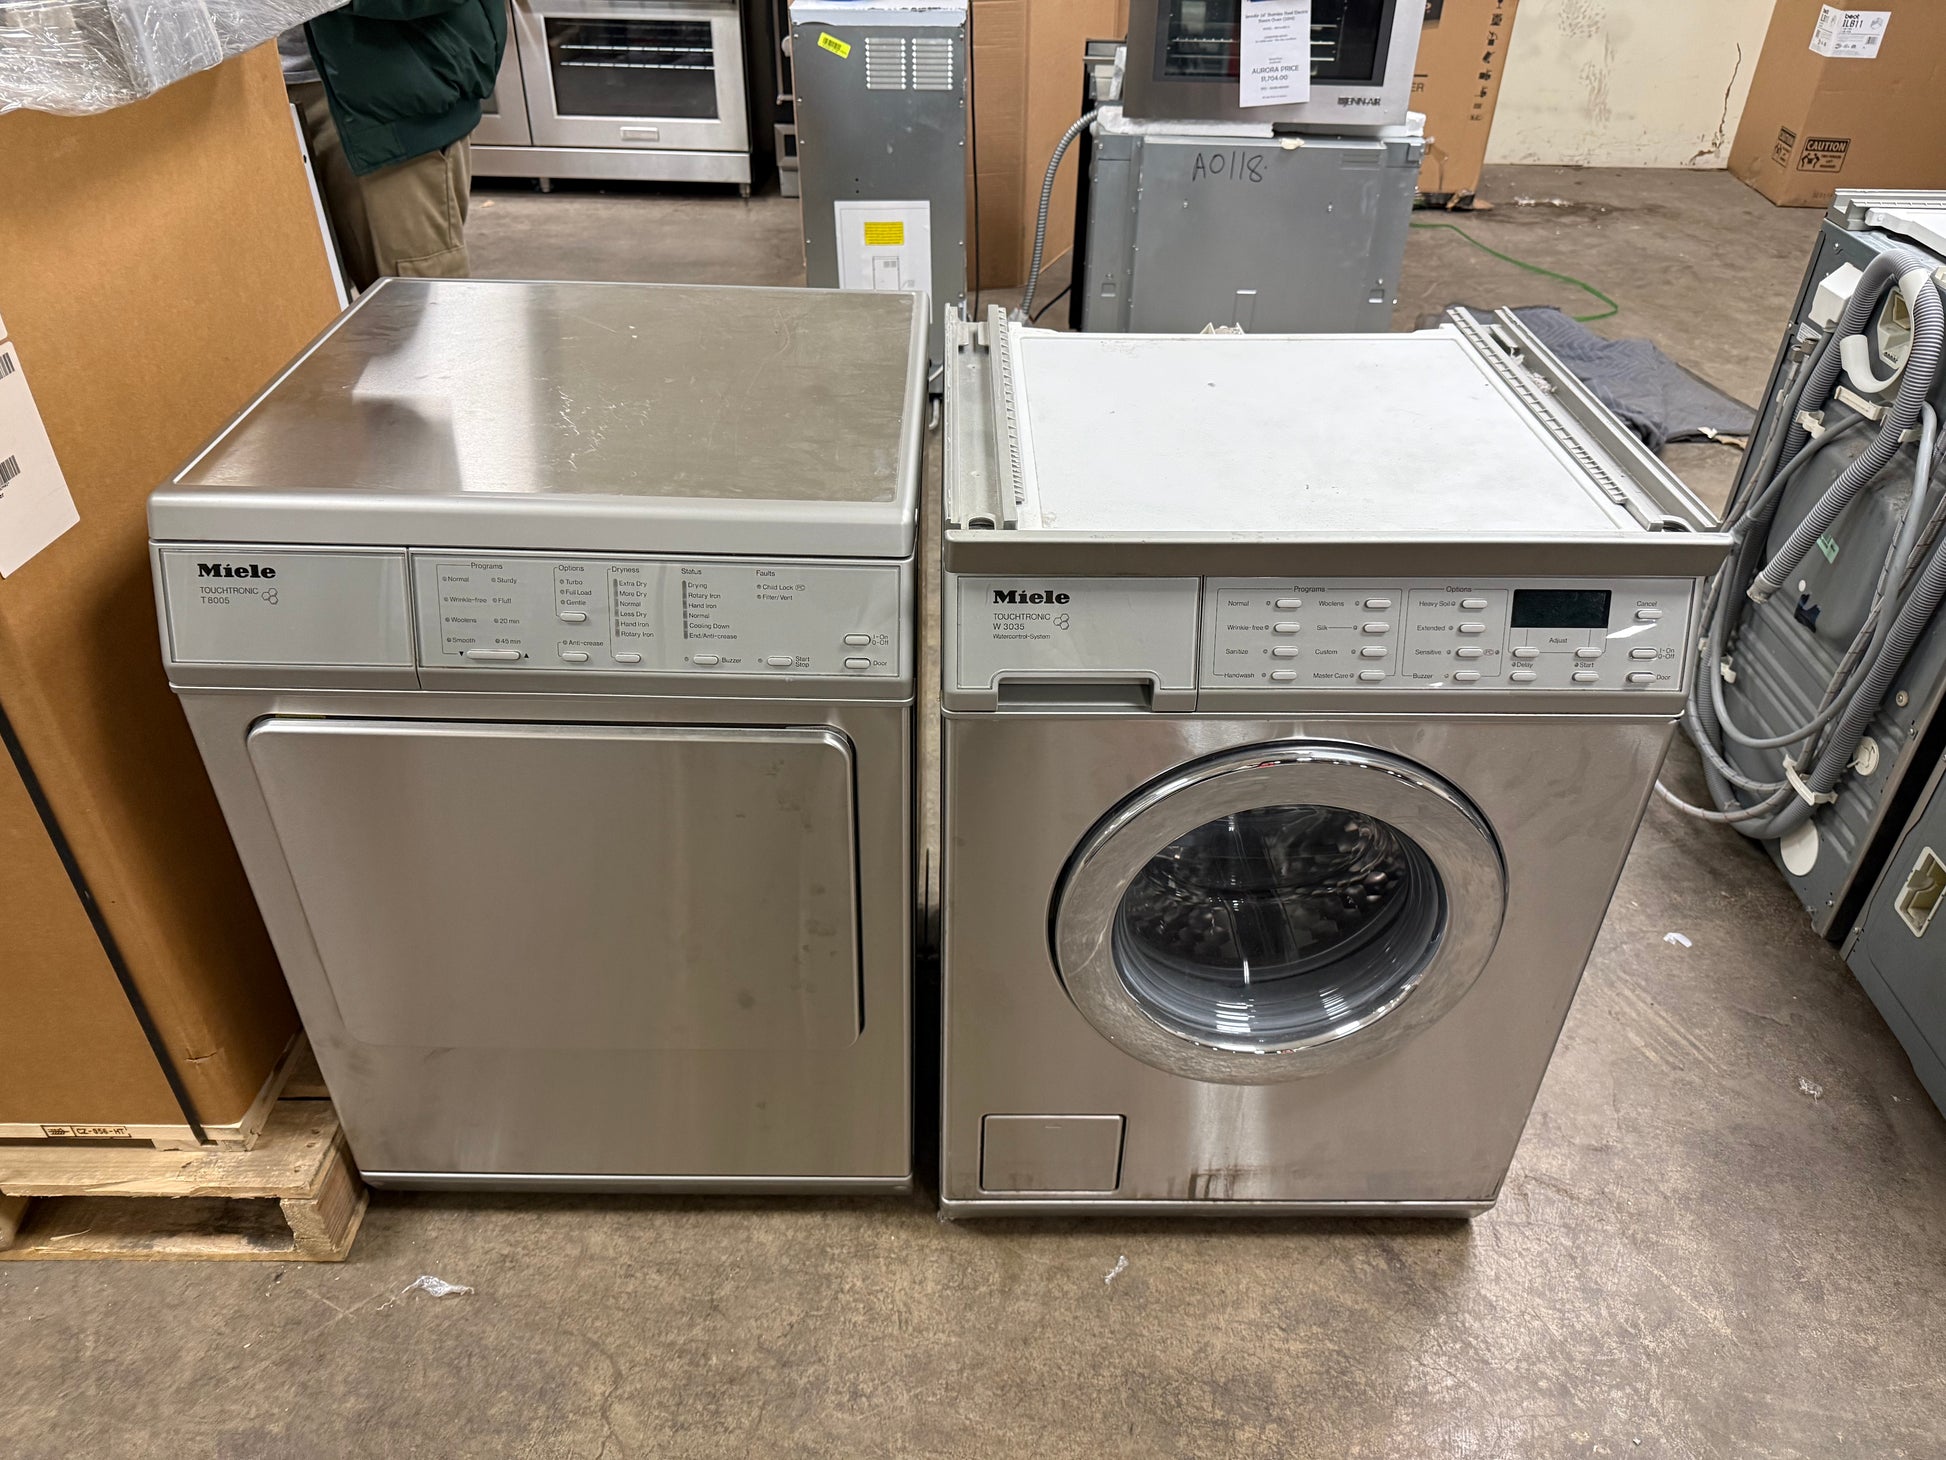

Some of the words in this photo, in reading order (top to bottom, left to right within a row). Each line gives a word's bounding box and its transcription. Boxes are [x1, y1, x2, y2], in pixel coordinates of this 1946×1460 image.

[1807, 141, 1846, 151] CAUTION
[198, 563, 276, 578] Miele
[612, 566, 639, 574] Dryness
[200, 586, 258, 595] TOUCHTRONIC
[993, 590, 1070, 604] Miele
[1516, 661, 1533, 669] Delay
